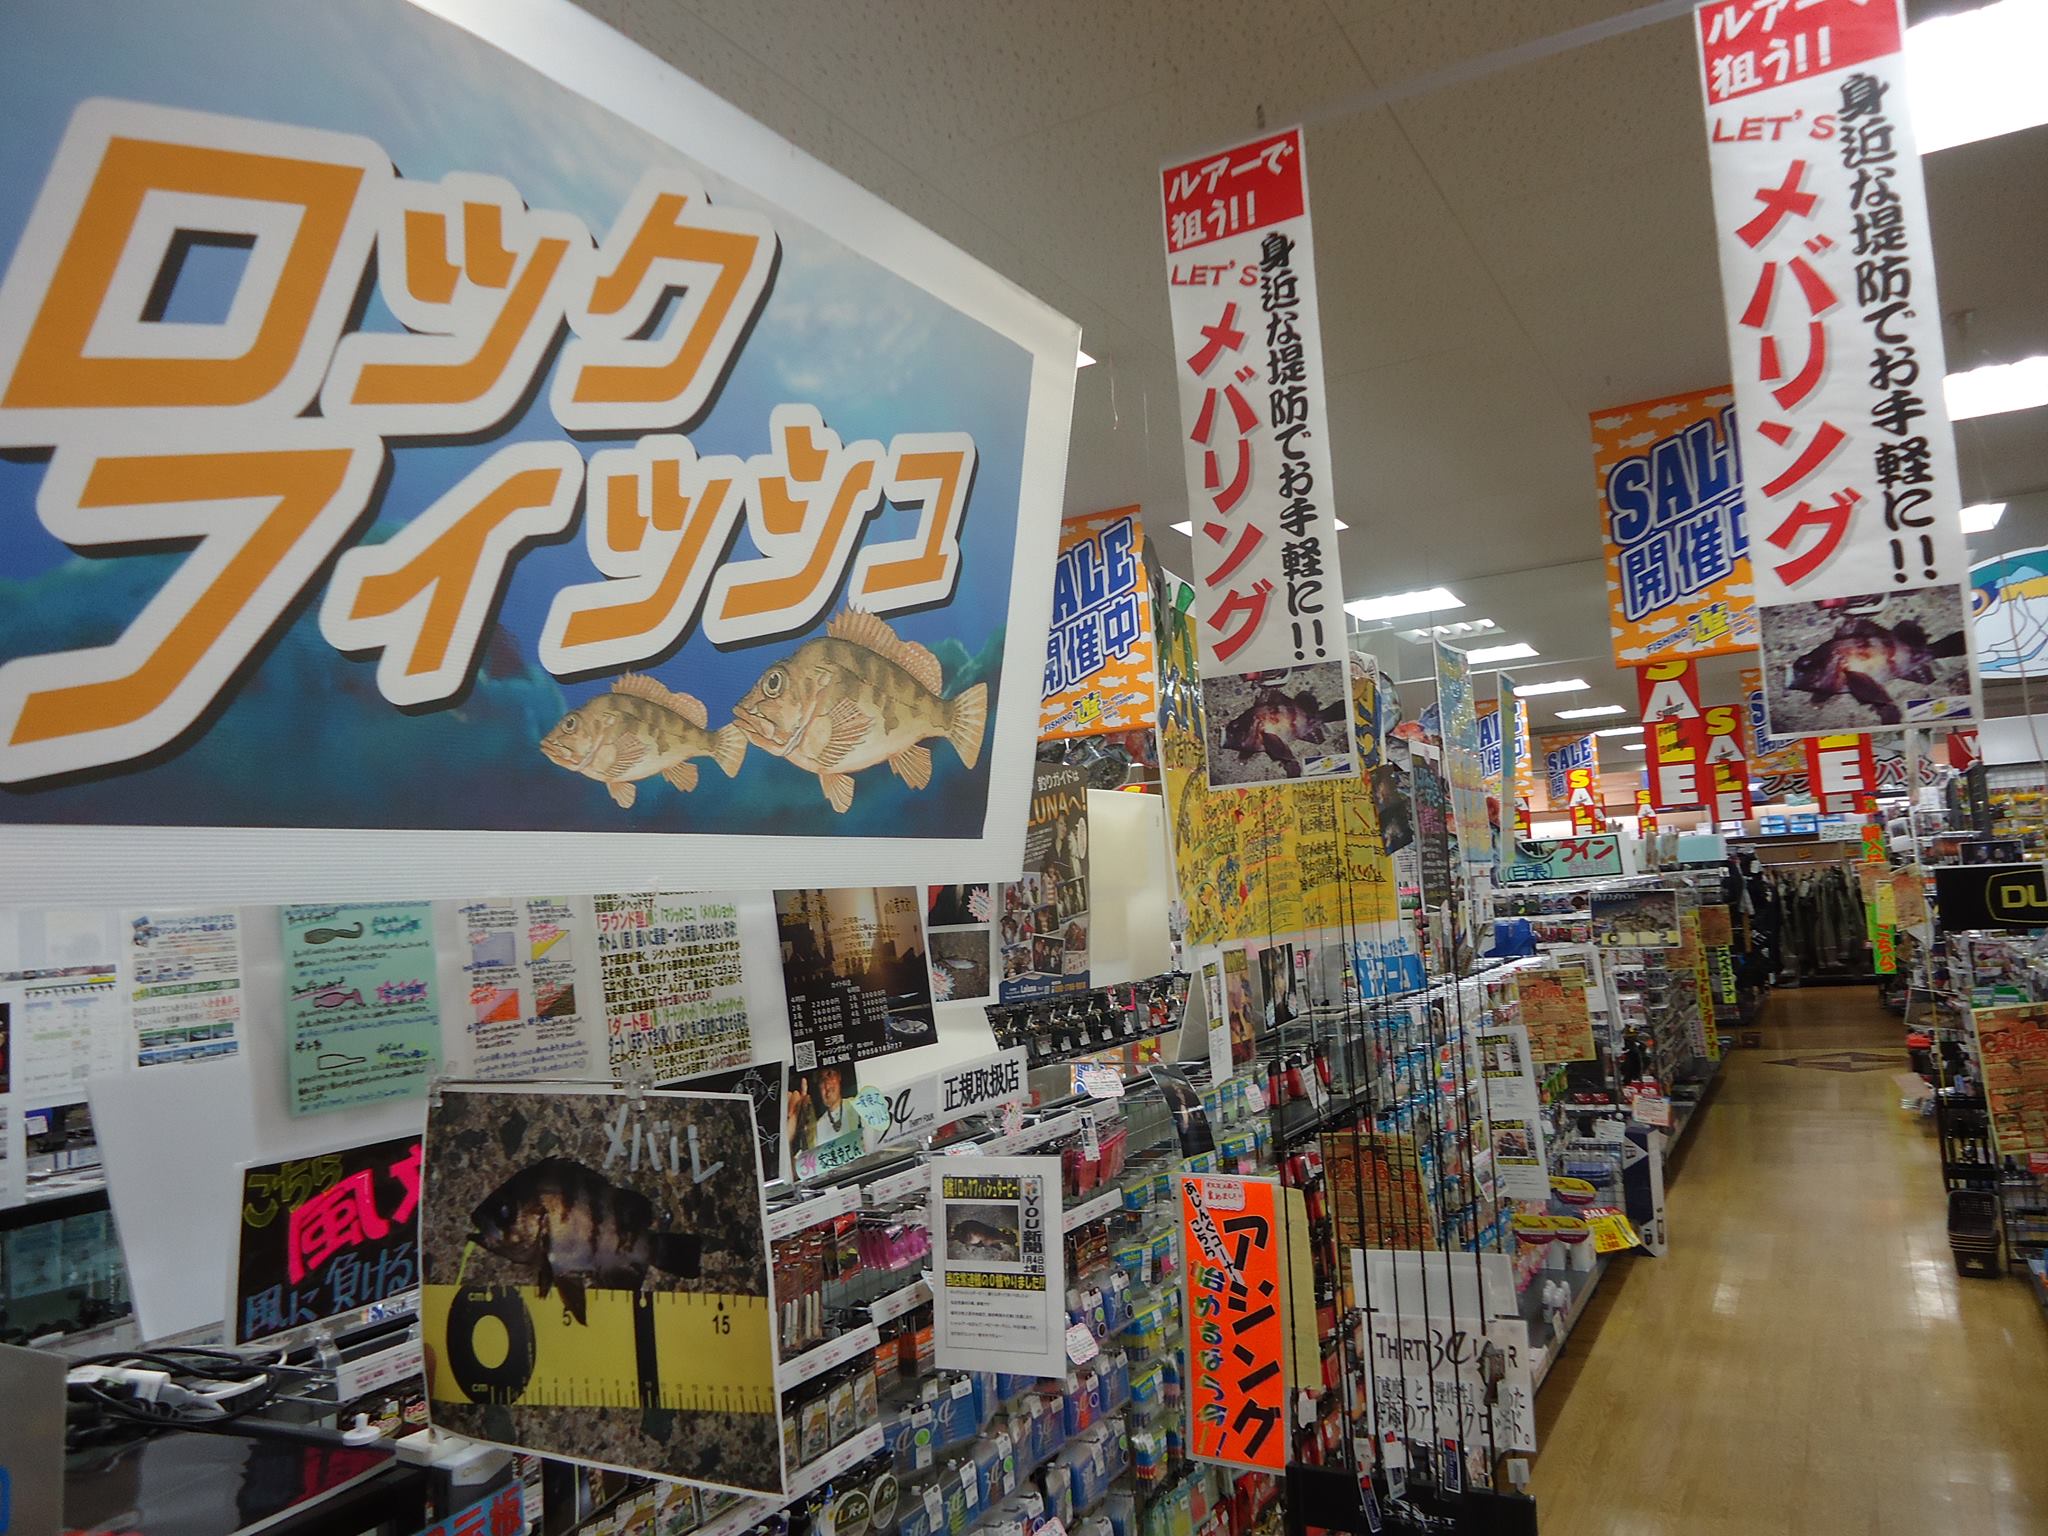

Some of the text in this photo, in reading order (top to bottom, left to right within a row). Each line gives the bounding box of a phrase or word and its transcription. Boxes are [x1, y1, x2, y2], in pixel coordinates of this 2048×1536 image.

[1712, 109, 1837, 143] LET'S
[1169, 141, 1293, 202] ルアーで
[0, 100, 774, 438] ロック
[1171, 260, 1258, 287] LET'S
[1735, 159, 1862, 586] メバリング
[1187, 302, 1275, 662] メバリング
[1607, 403, 1744, 547] SAL
[0, 408, 972, 778] フィッシュ
[1050, 516, 1136, 629] ALE
[1646, 629, 1689, 654] FISHING
[1044, 711, 1073, 733] FISHING
[1549, 735, 1592, 778] SALE
[1705, 707, 1745, 821] SALE
[1559, 838, 1615, 862] ライン
[944, 1059, 1019, 1112] 正規取扱店
[243, 1155, 343, 1228] こちら
[1191, 1219, 1216, 1258] こちら
[711, 1315, 731, 1336] 15
[1223, 1215, 1281, 1459] アジング
